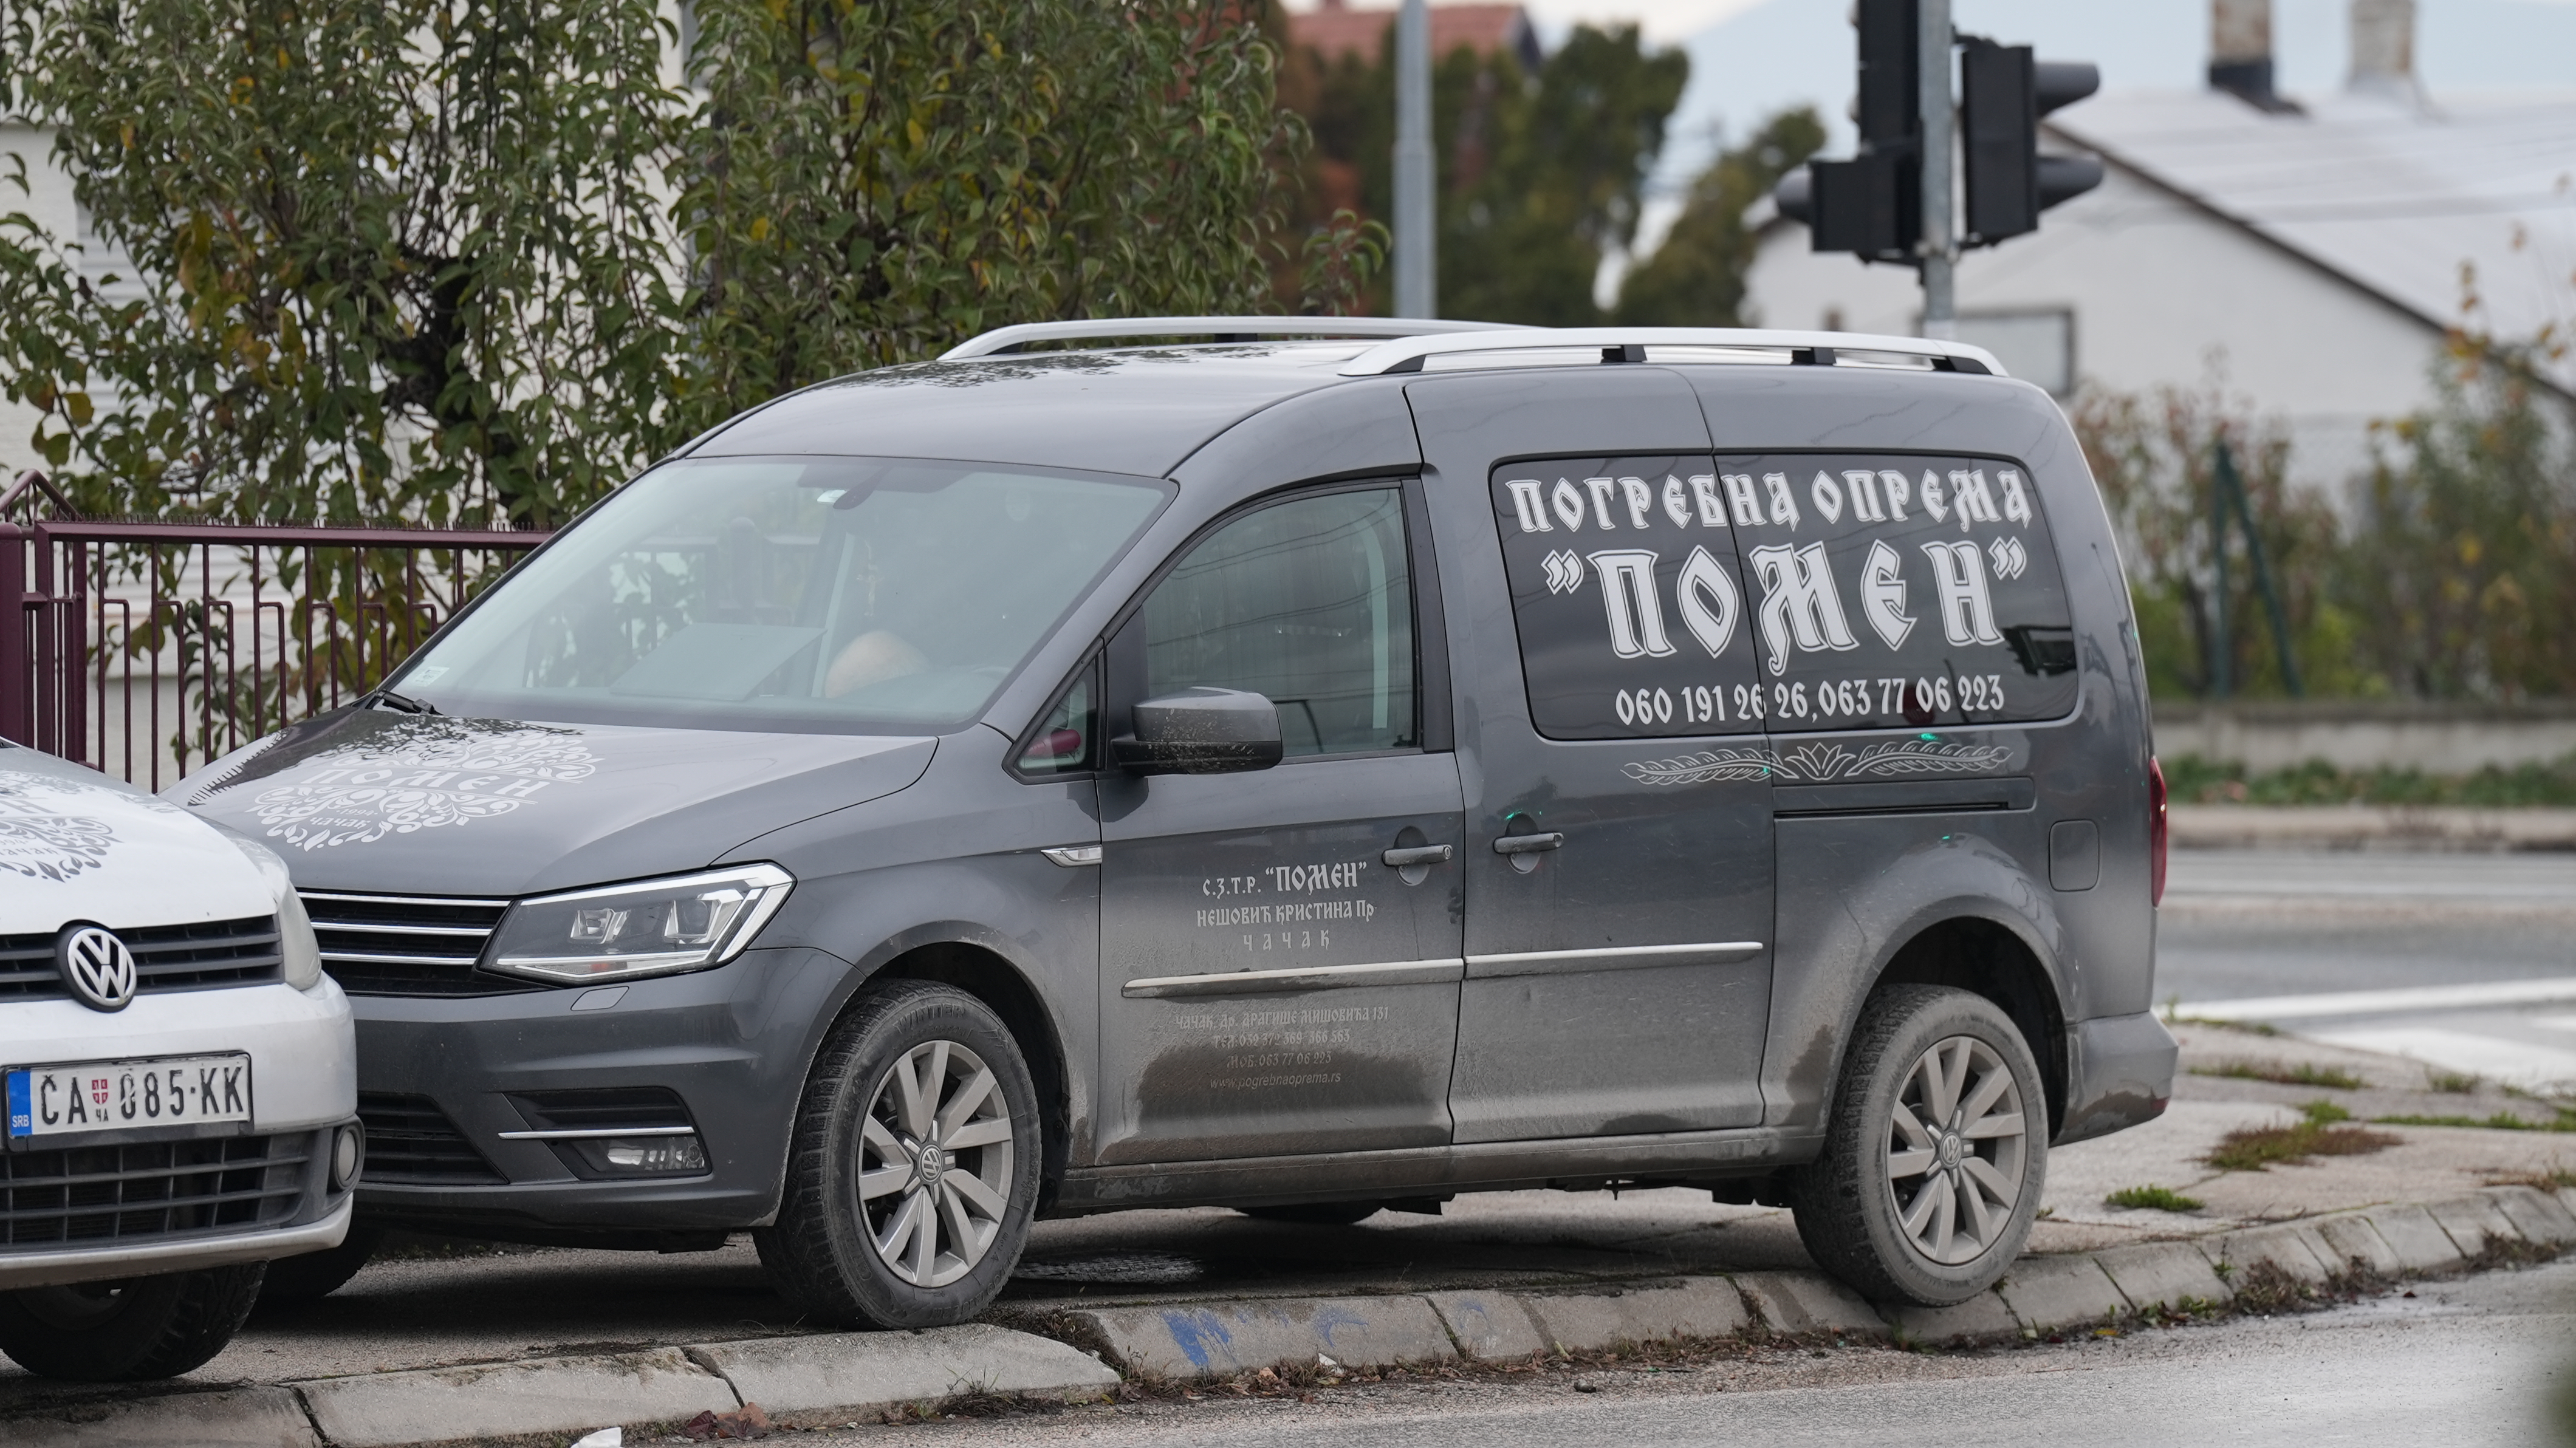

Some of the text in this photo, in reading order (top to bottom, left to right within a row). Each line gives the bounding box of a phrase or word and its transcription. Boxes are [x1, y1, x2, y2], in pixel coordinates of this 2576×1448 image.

[1505, 469, 2032, 531] ПОГРЕБНА ОПРЕМА
[1615, 689, 1673, 725] 060
[1681, 685, 1725, 722] 191
[1734, 683, 1767, 720] 26
[1877, 678, 1905, 714] 77
[1916, 676, 1951, 712] 06
[1958, 674, 2004, 711] 223
[301, 768, 550, 798] ПОМЕН
[1197, 906, 1272, 927] НЕШОВИЋ
[1275, 901, 1352, 925] КРИСТИНА
[1373, 1006, 1389, 1020] 131
[1297, 1052, 1310, 1065] 06
[1314, 1051, 1332, 1064] 223
[12, 1115, 29, 1128] SRB
